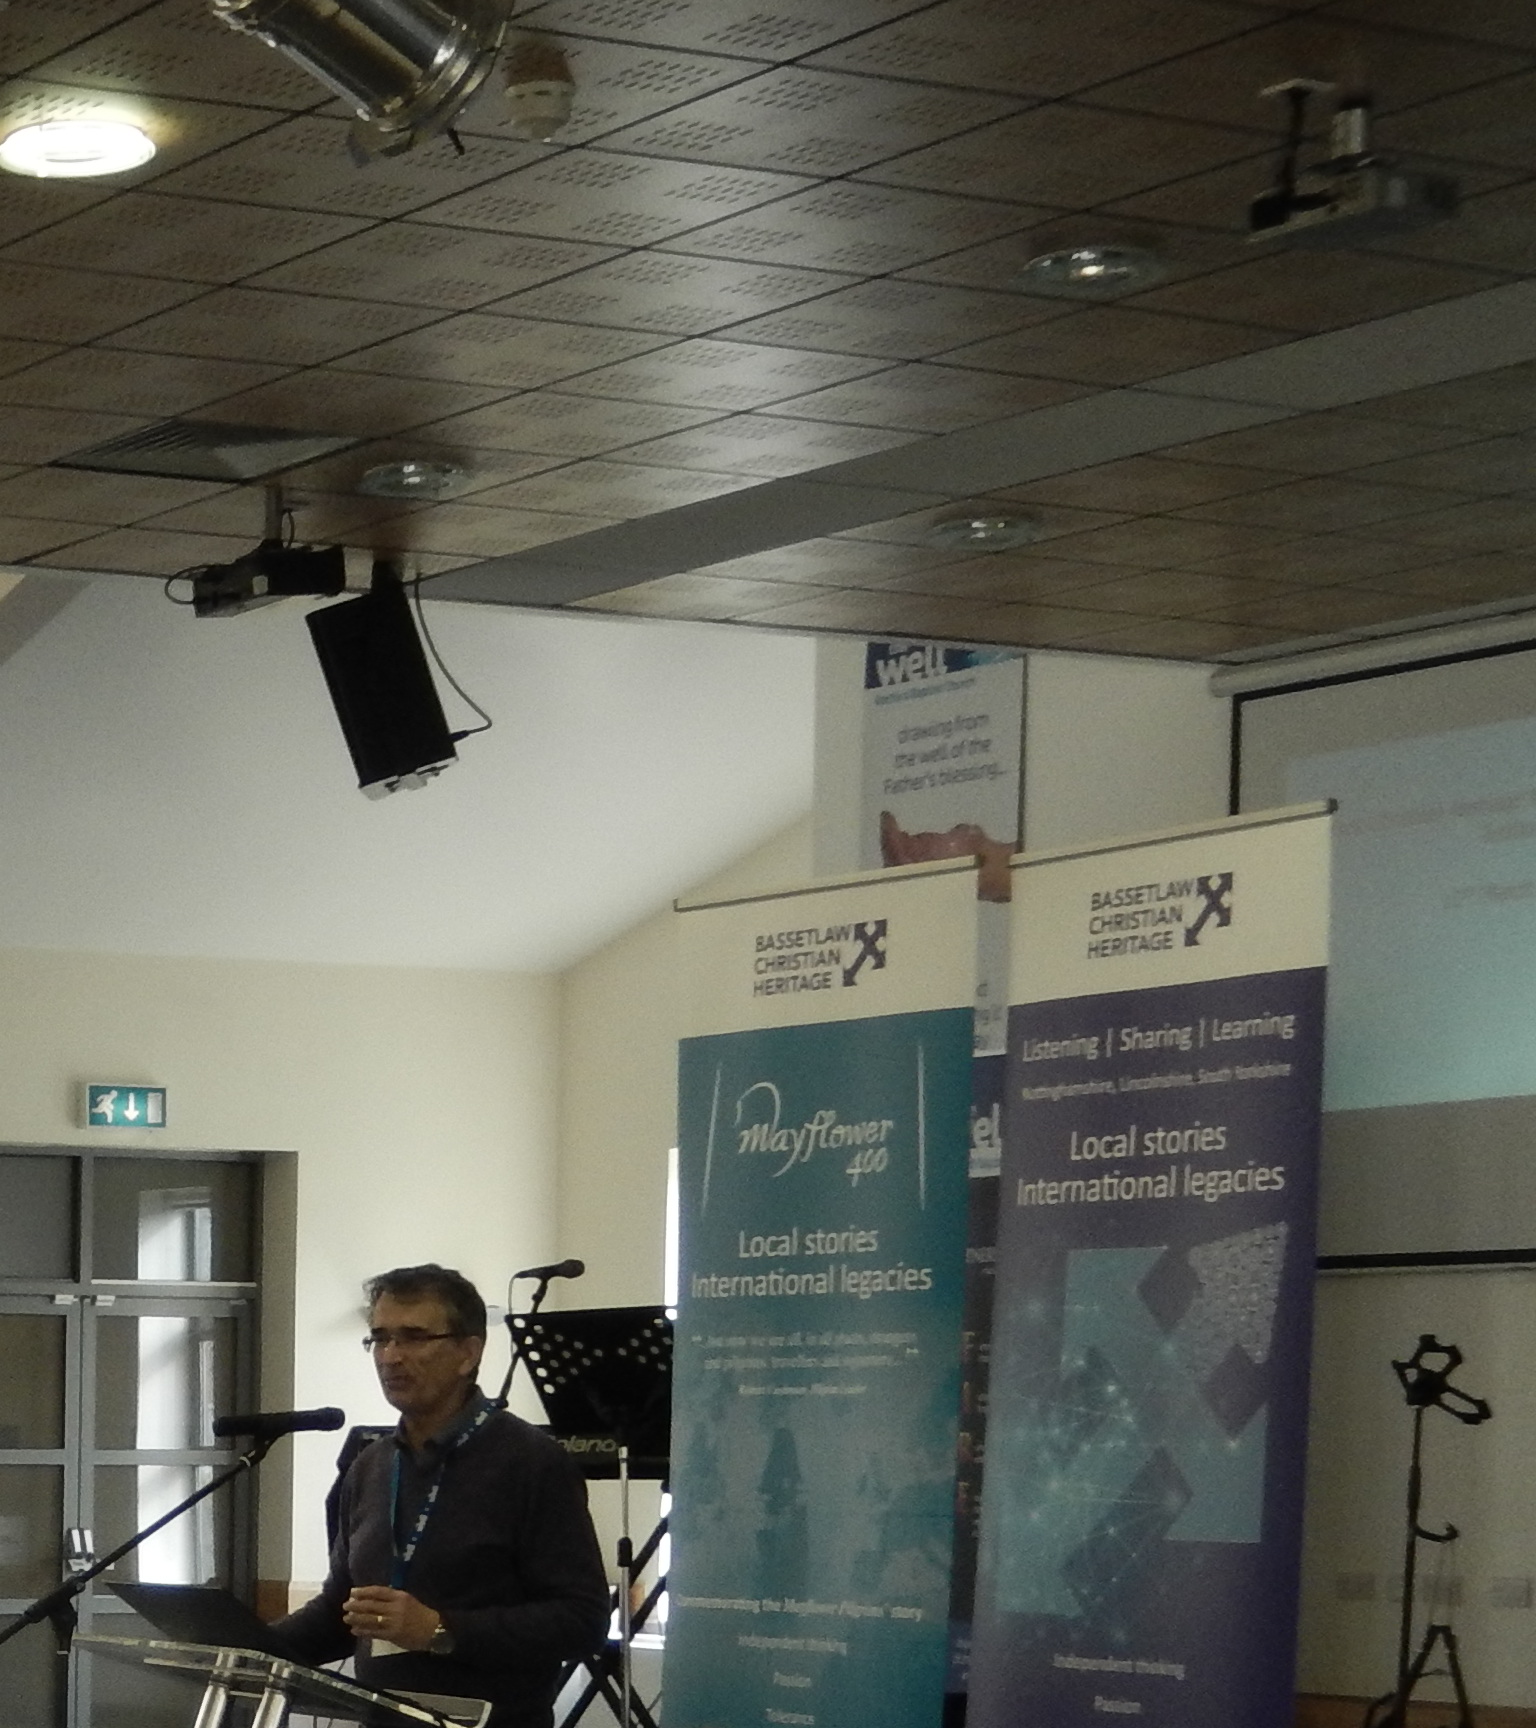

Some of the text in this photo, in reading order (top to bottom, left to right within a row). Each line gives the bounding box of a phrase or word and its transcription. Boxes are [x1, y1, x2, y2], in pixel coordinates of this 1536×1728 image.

[876, 643, 946, 688] well
[1091, 878, 1195, 911] BASSETLAW
[1089, 905, 1183, 935] CHRISTIAN
[755, 924, 853, 952] BASSETLAW
[1087, 930, 1173, 959] HERITAGE
[754, 949, 840, 975] CHRISTIAN
[753, 971, 832, 997] HERITAGE
[1022, 1033, 1099, 1062] Listening
[1119, 1023, 1193, 1051] Sharing
[1212, 1011, 1296, 1042] Learning
[734, 1082, 894, 1177] Mayflower
[1070, 1120, 1227, 1161] Local stories
[1017, 1160, 1285, 1206] International legacies
[738, 1224, 879, 1258] Local stories
[691, 1261, 933, 1300] International legacies
